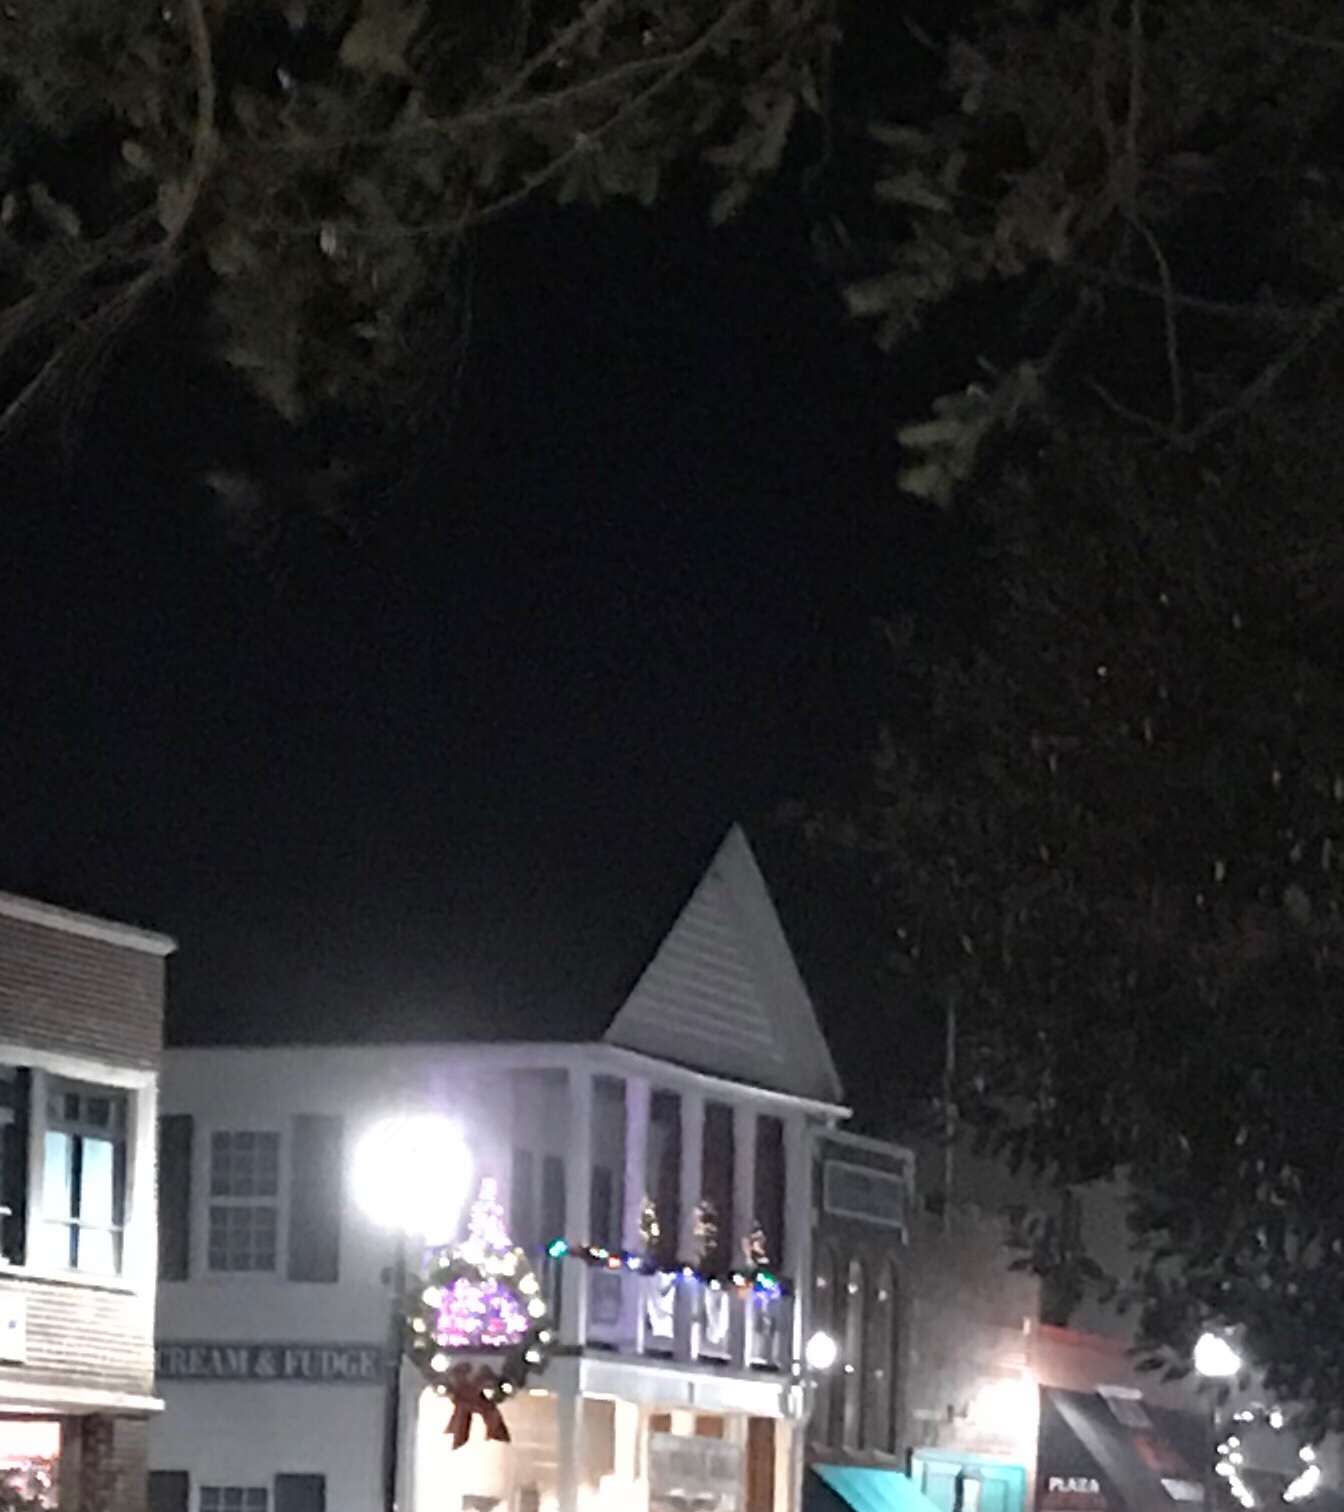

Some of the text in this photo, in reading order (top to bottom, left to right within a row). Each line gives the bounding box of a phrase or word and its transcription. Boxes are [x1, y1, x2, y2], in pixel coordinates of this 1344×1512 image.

[255, 1349, 277, 1376] &
[284, 1349, 378, 1377] FUDGE
[1048, 1476, 1100, 1493] PLAZA
